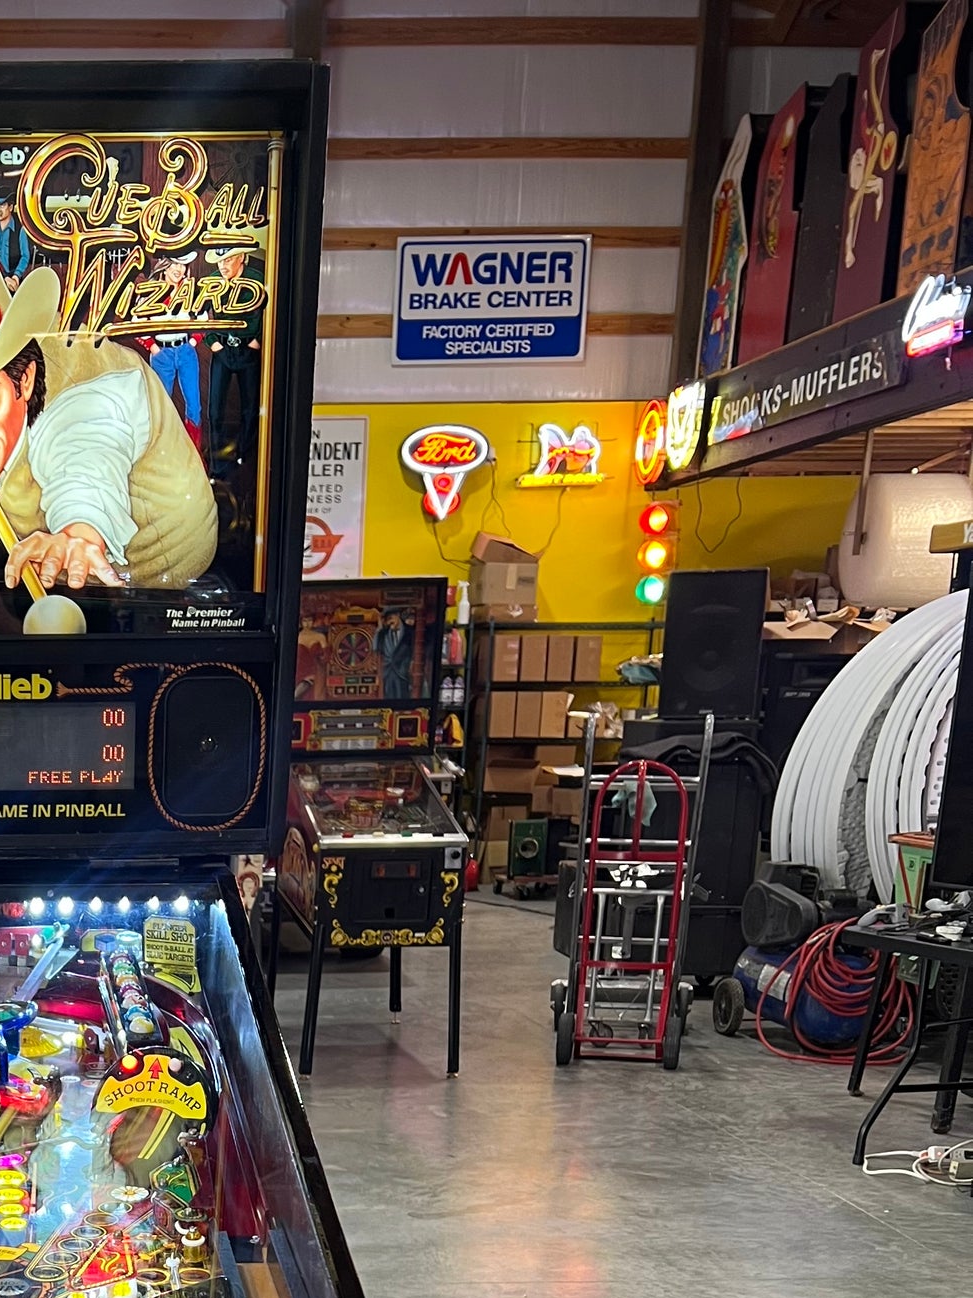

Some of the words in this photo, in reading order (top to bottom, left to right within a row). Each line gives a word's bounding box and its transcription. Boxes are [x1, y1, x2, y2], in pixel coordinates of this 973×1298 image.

[411, 251, 574, 287] WAGNER
[409, 292, 481, 310] BRAKE
[487, 290, 573, 308] CENTER
[422, 324, 483, 339] FACTORY
[485, 322, 555, 337] CERTIFIED
[445, 339, 531, 355] SPECIALISTS
[414, 431, 477, 463] Ford
[166, 608, 183, 618] The
[186, 605, 234, 618] Premier
[171, 618, 199, 628] Name
[211, 618, 245, 627] Pinball
[101, 708, 126, 727] 00
[101, 744, 125, 762] 00
[28, 770, 73, 784] FREE
[80, 769, 124, 784] PLAY
[32, 803, 55, 818] IN
[58, 803, 126, 818] PINBALL
[146, 930, 170, 941] SKILL
[171, 931, 194, 943] SHOT
[104, 1080, 156, 1107] SHOOT
[158, 1081, 202, 1111] RAMP
